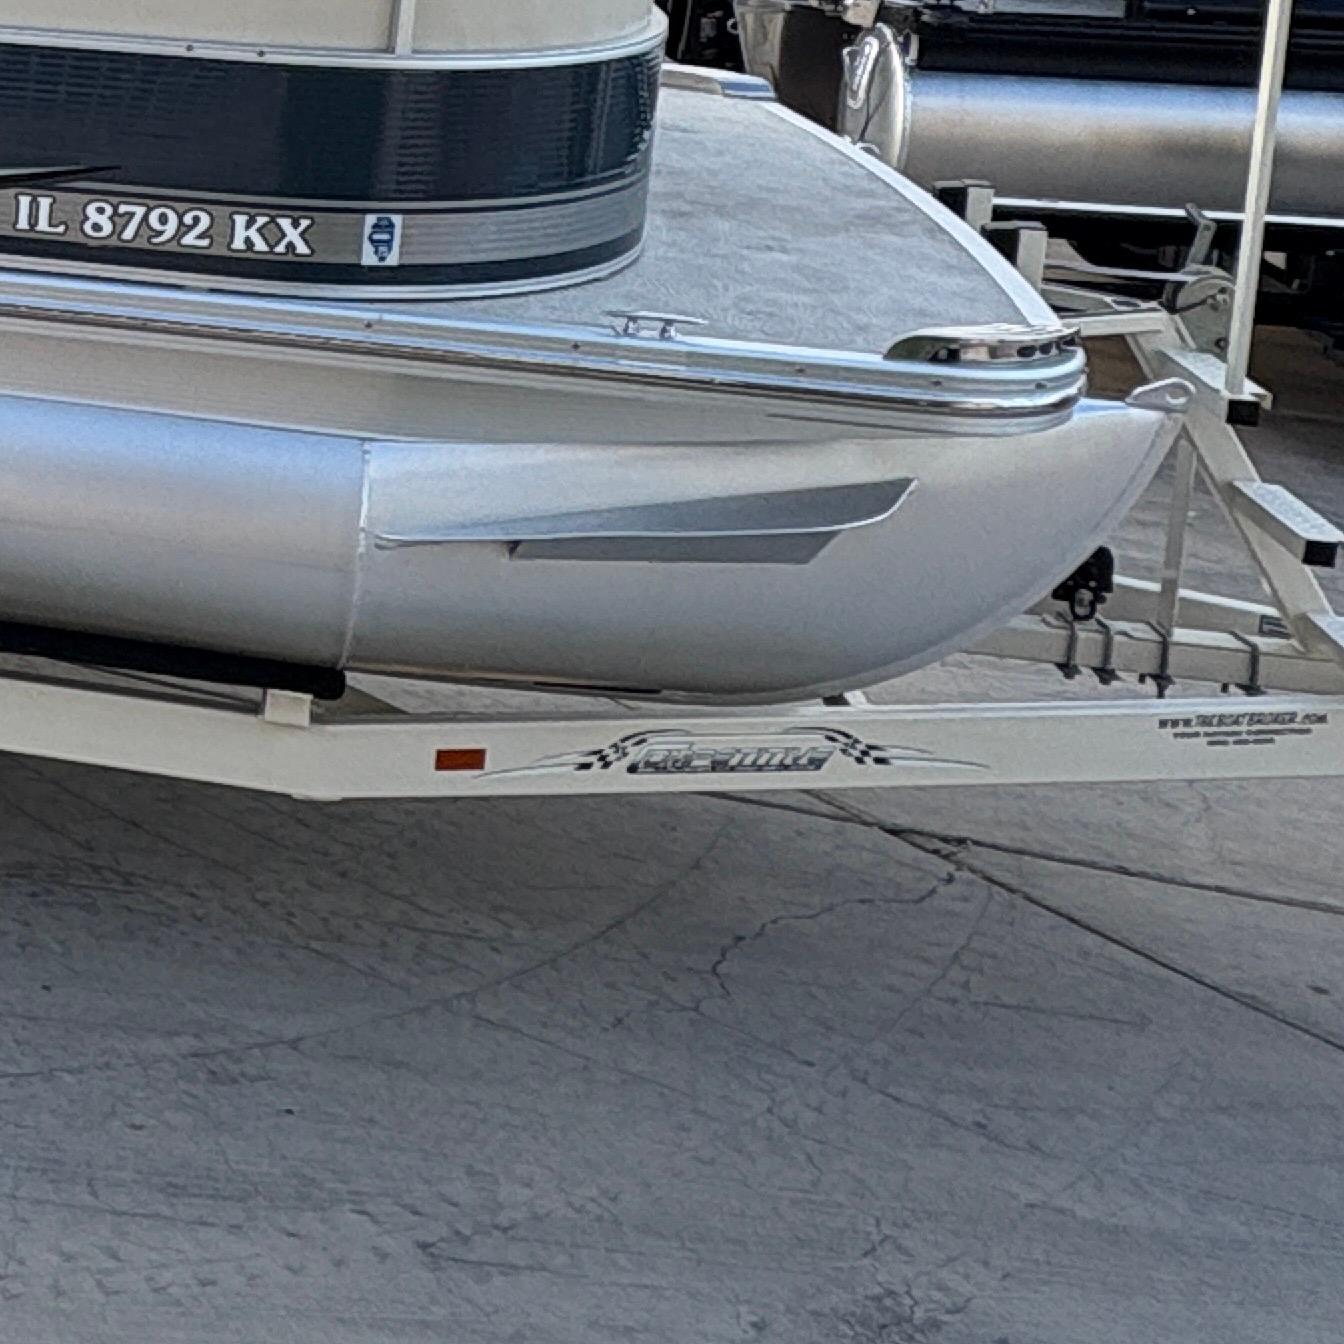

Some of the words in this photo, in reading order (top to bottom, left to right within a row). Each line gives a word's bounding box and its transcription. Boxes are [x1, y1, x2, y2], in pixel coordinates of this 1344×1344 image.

[14, 193, 67, 235] IL
[81, 200, 212, 248] 8792
[229, 212, 314, 256] KX
